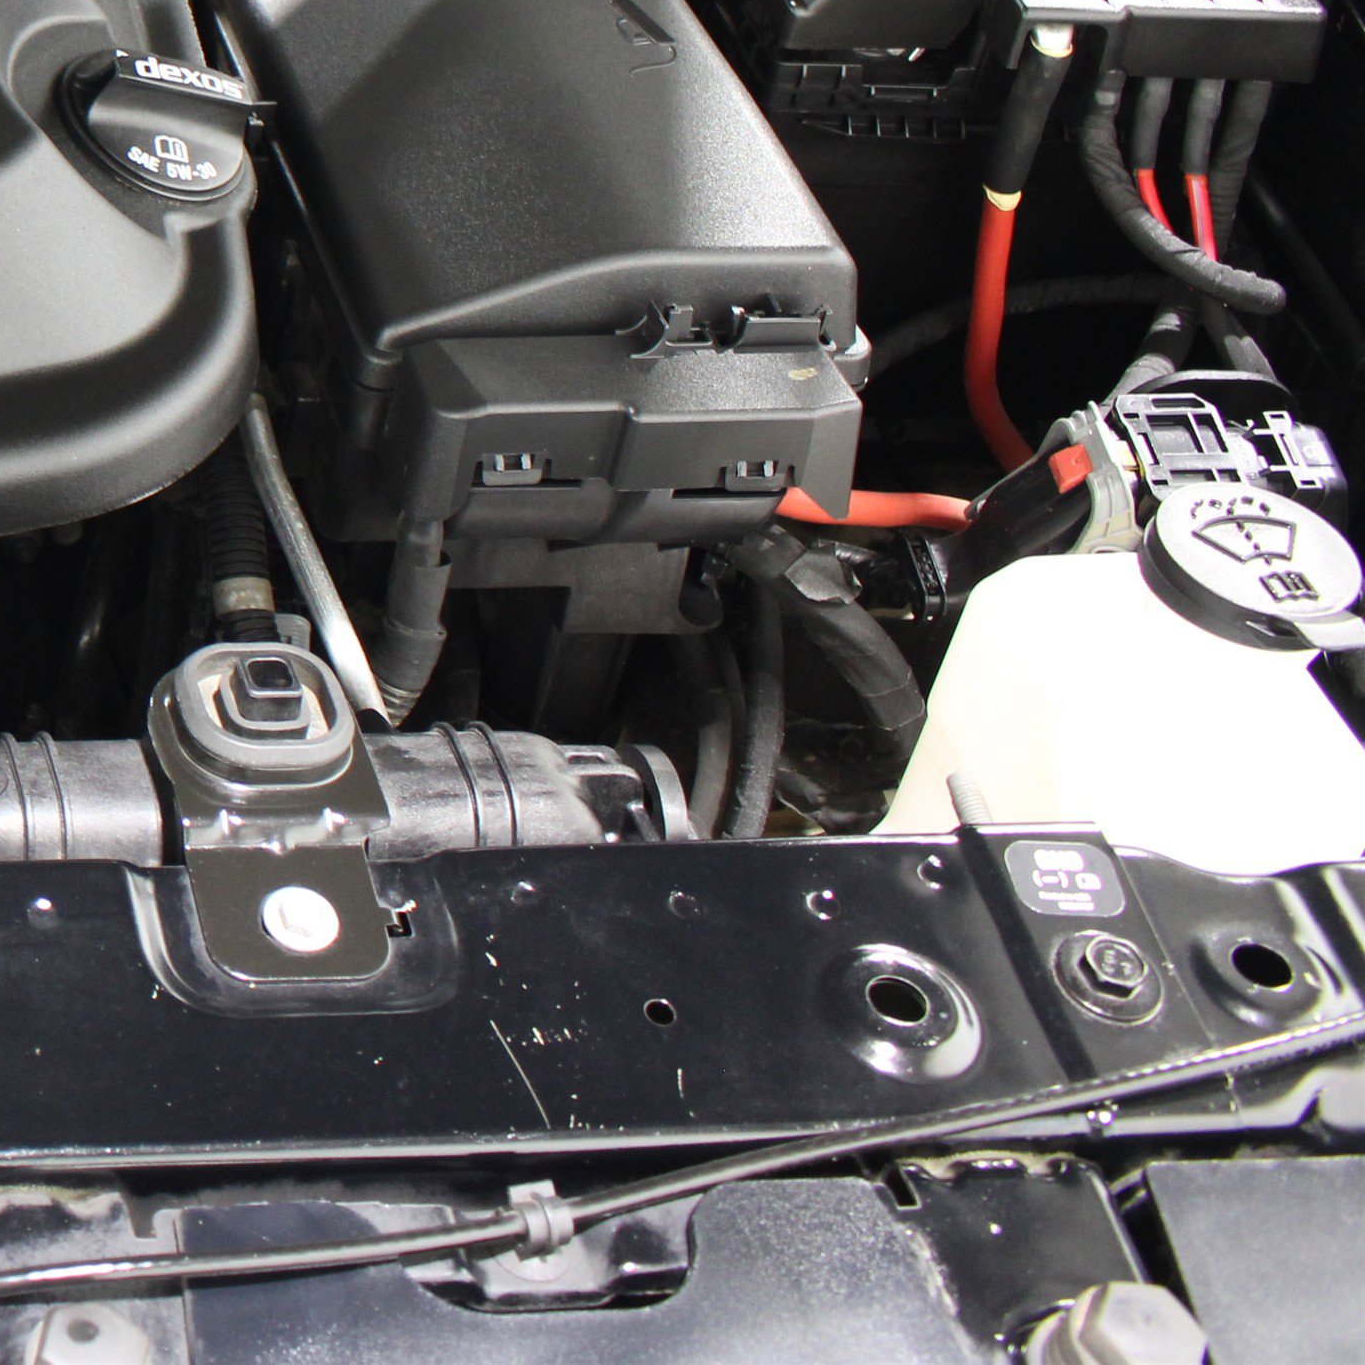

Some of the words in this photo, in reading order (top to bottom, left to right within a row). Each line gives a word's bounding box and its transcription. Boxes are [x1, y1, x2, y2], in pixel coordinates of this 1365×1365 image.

[134, 56, 243, 100] dexos
[127, 146, 160, 173] SAE
[166, 160, 217, 180] 5W-30
